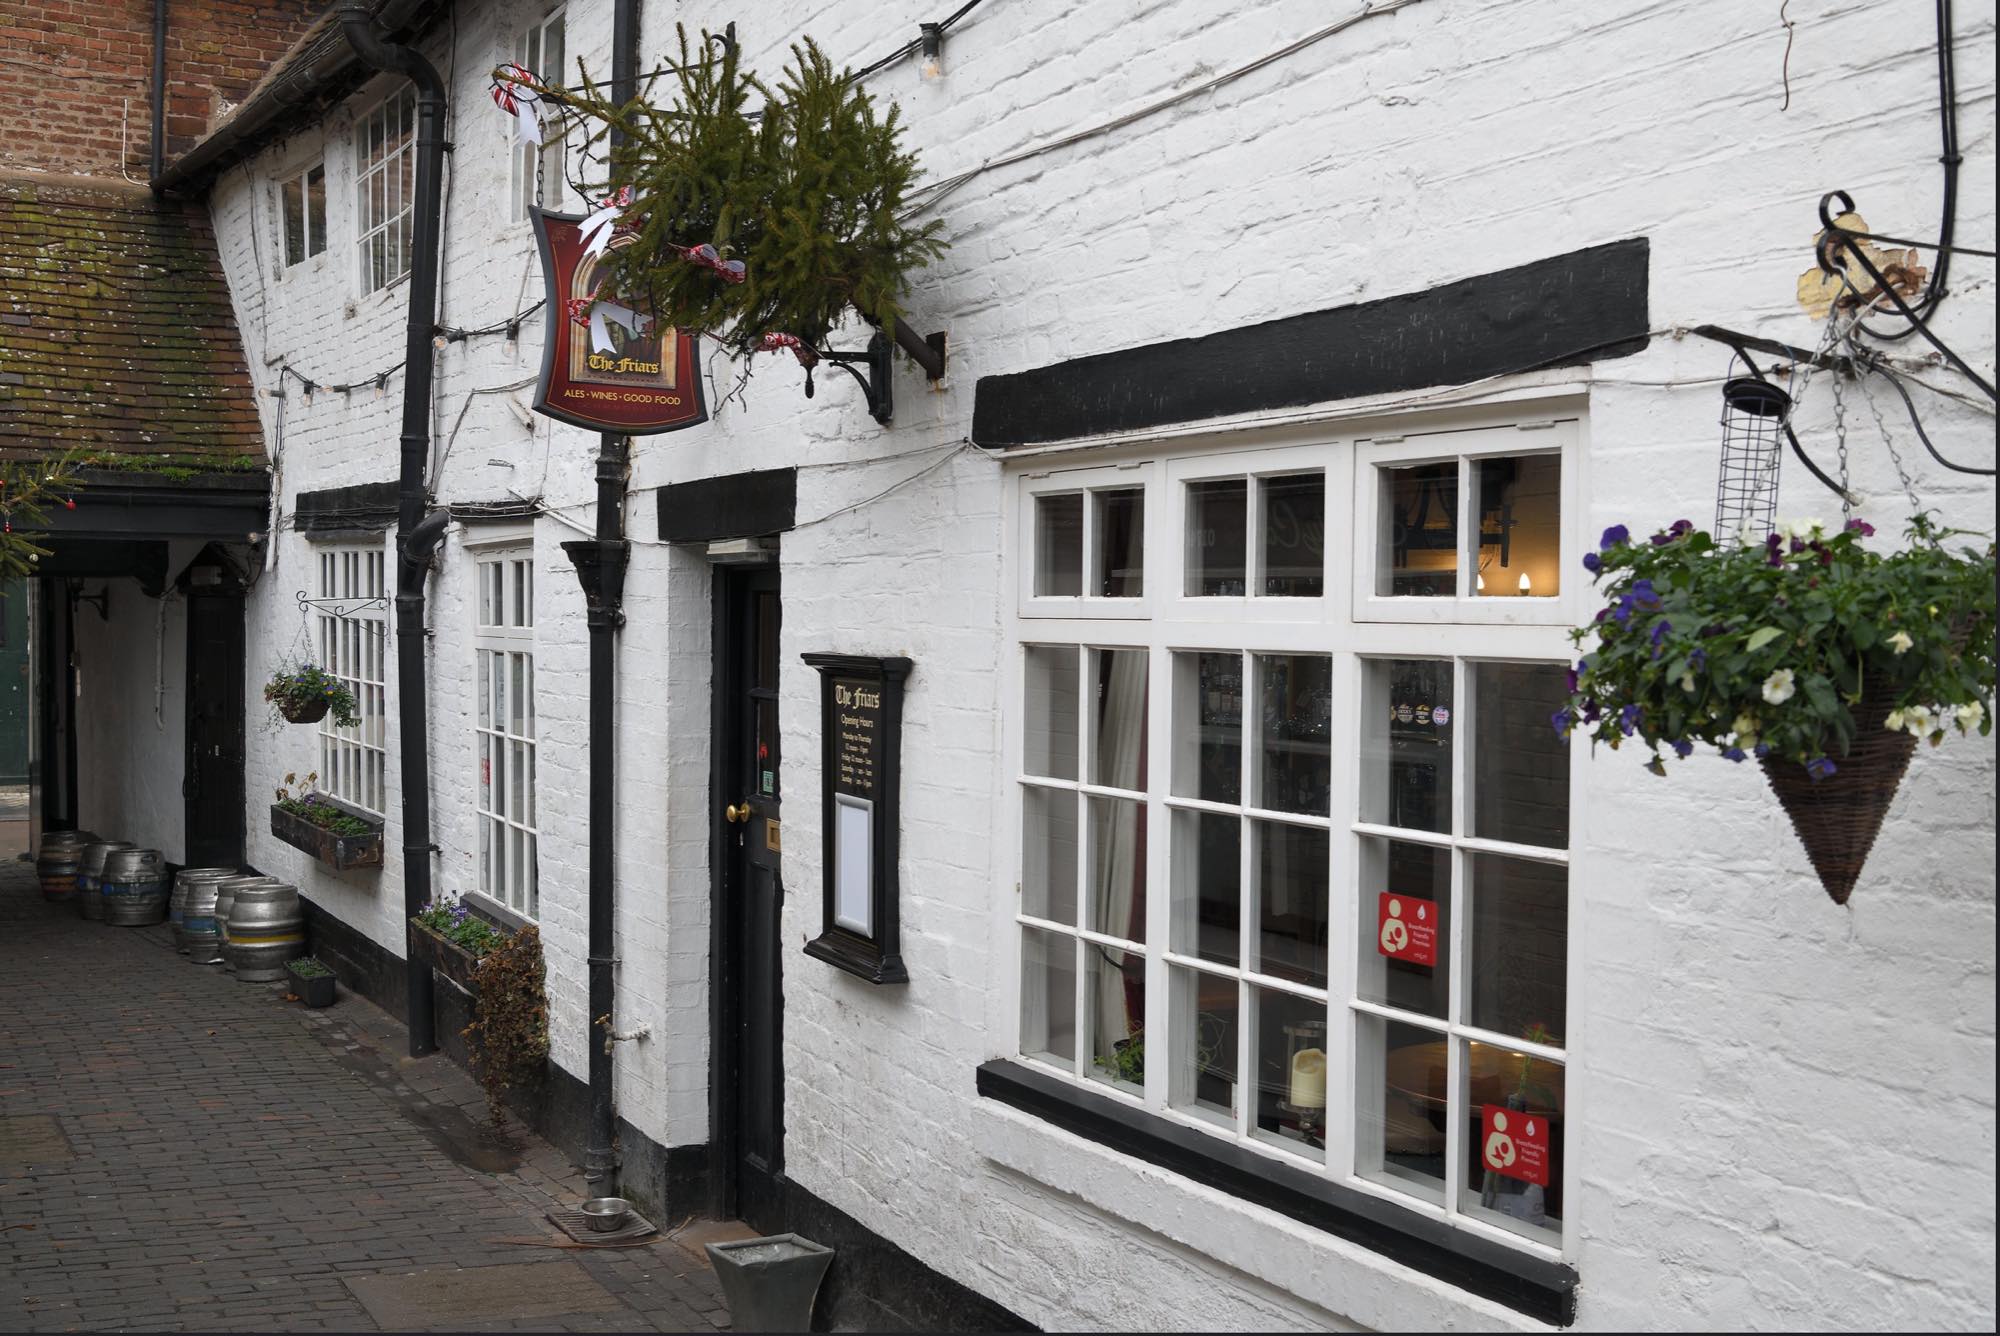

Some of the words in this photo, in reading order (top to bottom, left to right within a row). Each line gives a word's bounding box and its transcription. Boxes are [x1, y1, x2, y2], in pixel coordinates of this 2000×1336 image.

[588, 354, 615, 372] The
[564, 389, 585, 399] ALES
[591, 390, 618, 401] WINES
[623, 393, 652, 403] GOOD
[654, 395, 681, 406] FOOD
[835, 684, 852, 708] The
[841, 713, 860, 728] Opening
[859, 716, 874, 728] Hours
